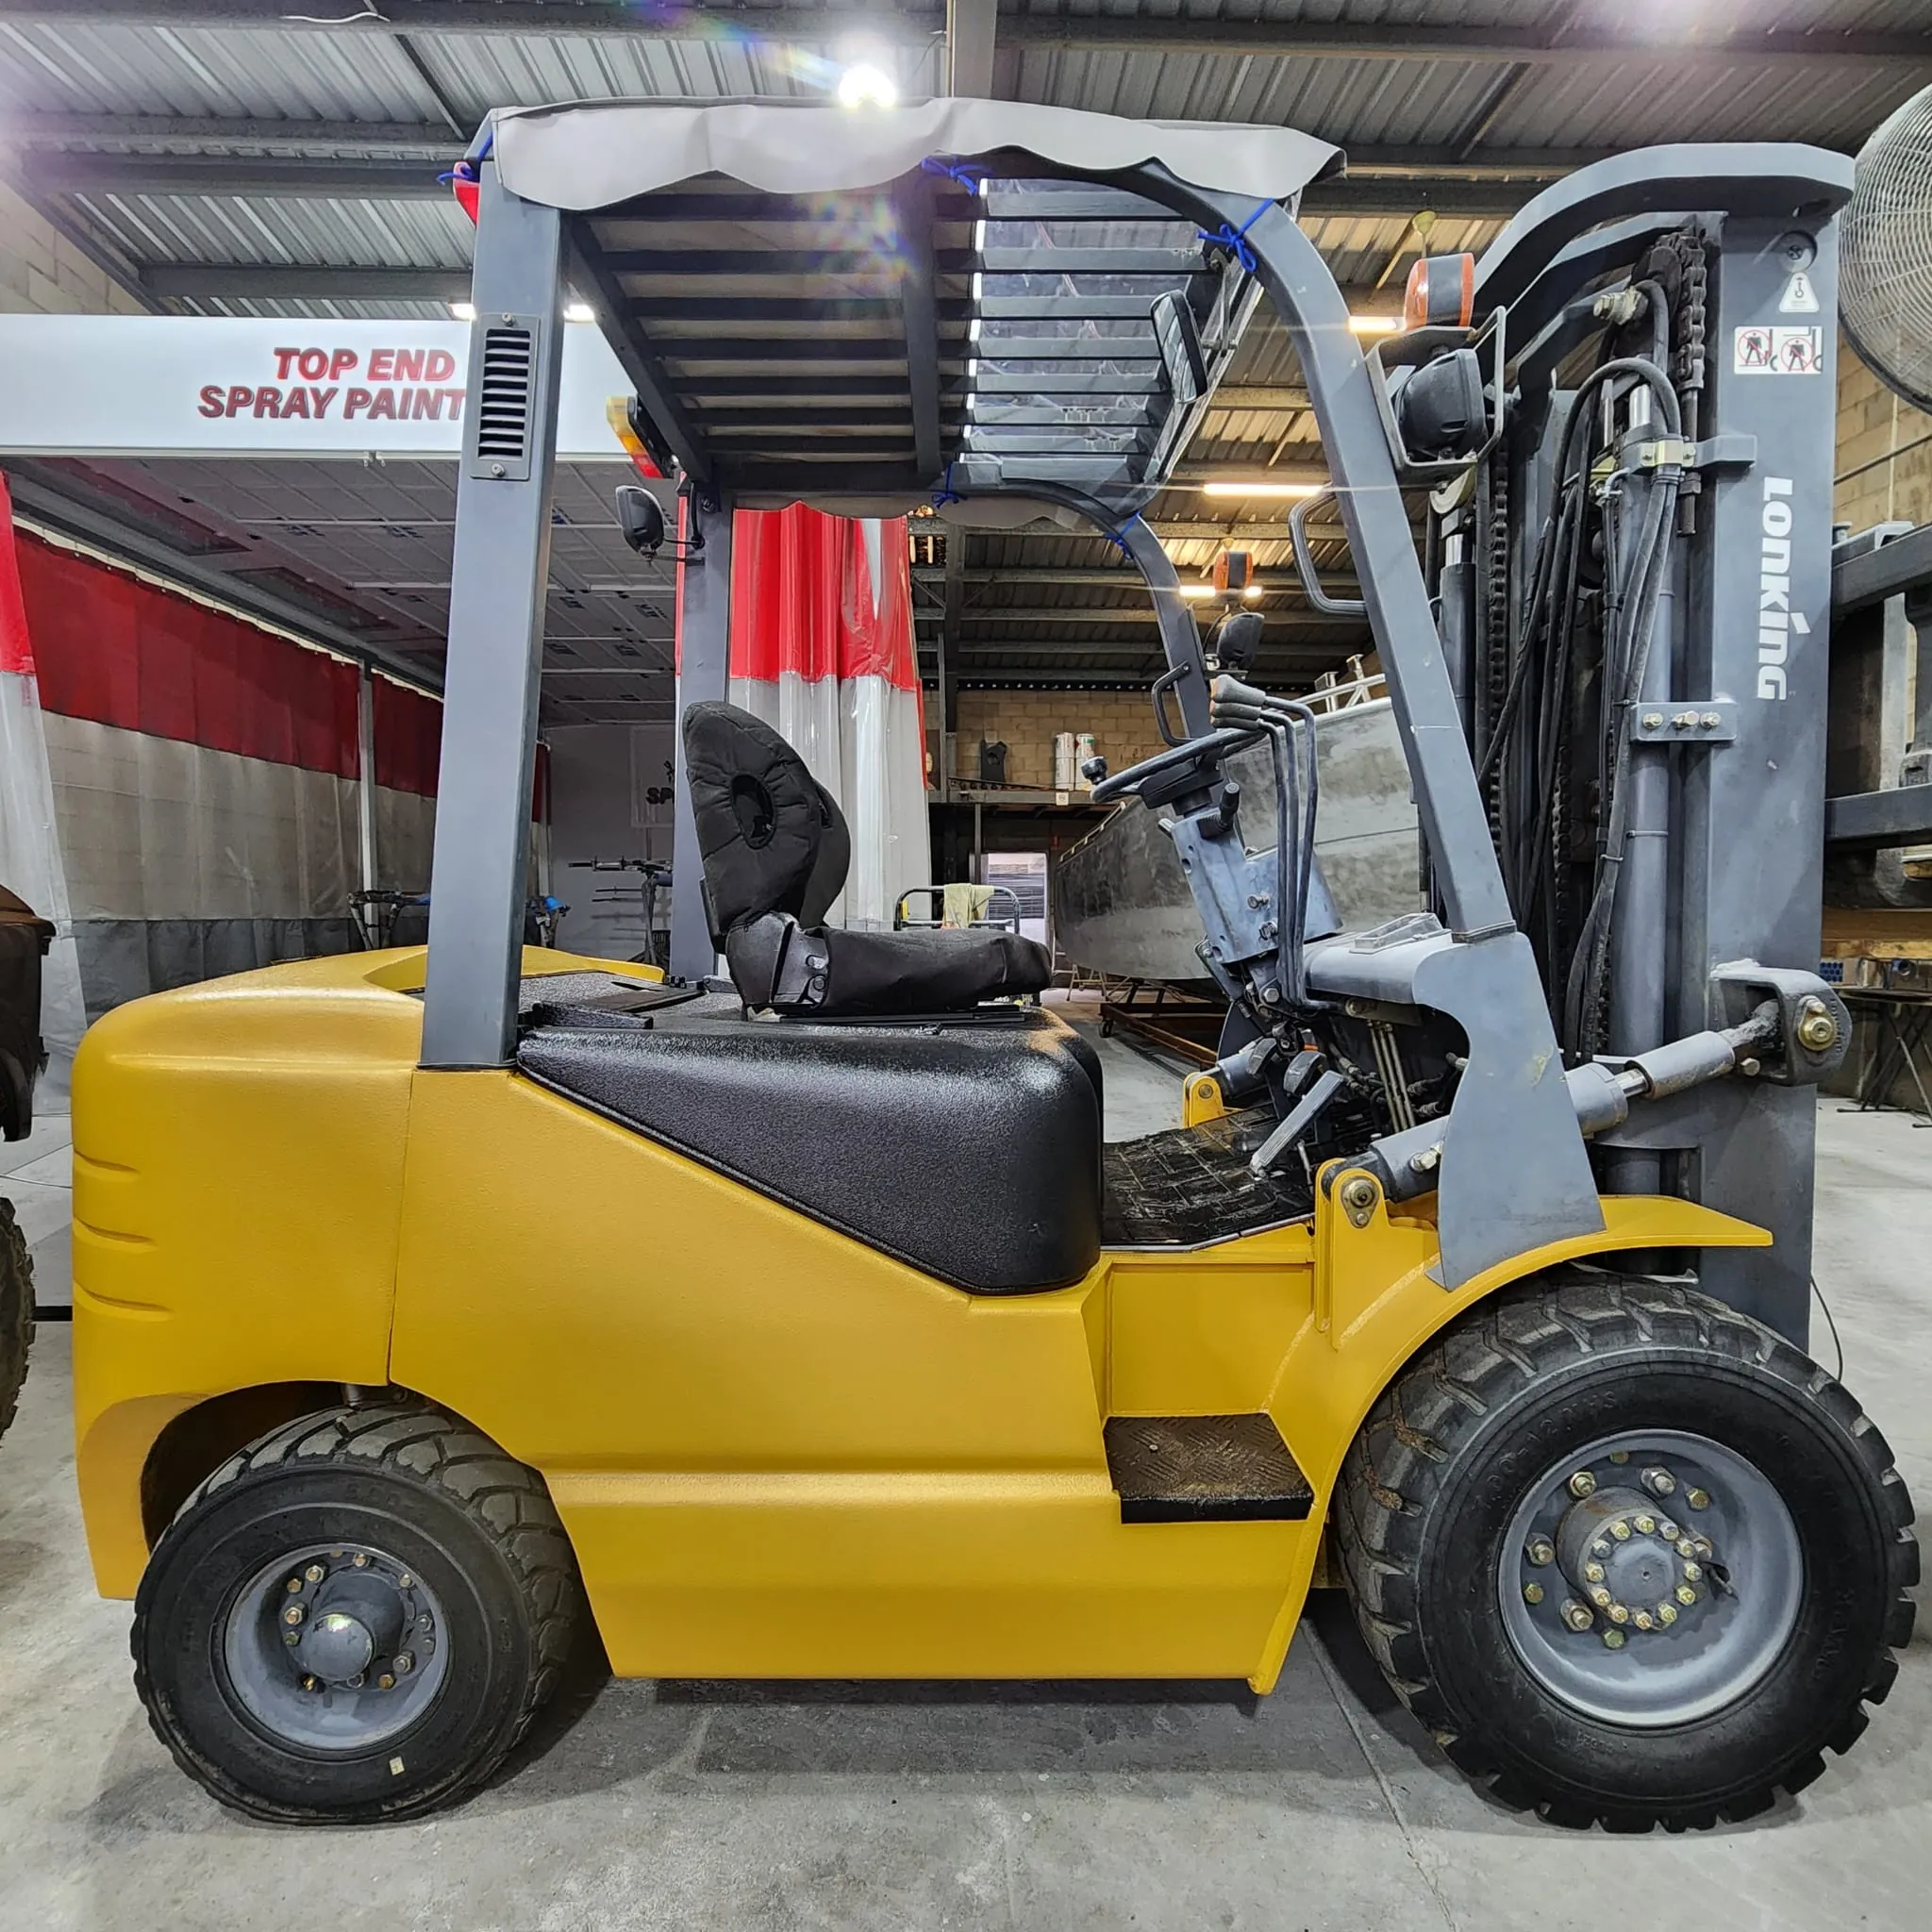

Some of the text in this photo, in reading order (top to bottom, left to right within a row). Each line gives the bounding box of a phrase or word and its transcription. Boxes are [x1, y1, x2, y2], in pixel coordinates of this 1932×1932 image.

[274, 347, 456, 381] TOP END
[197, 385, 466, 420] SPRAY PAINT
